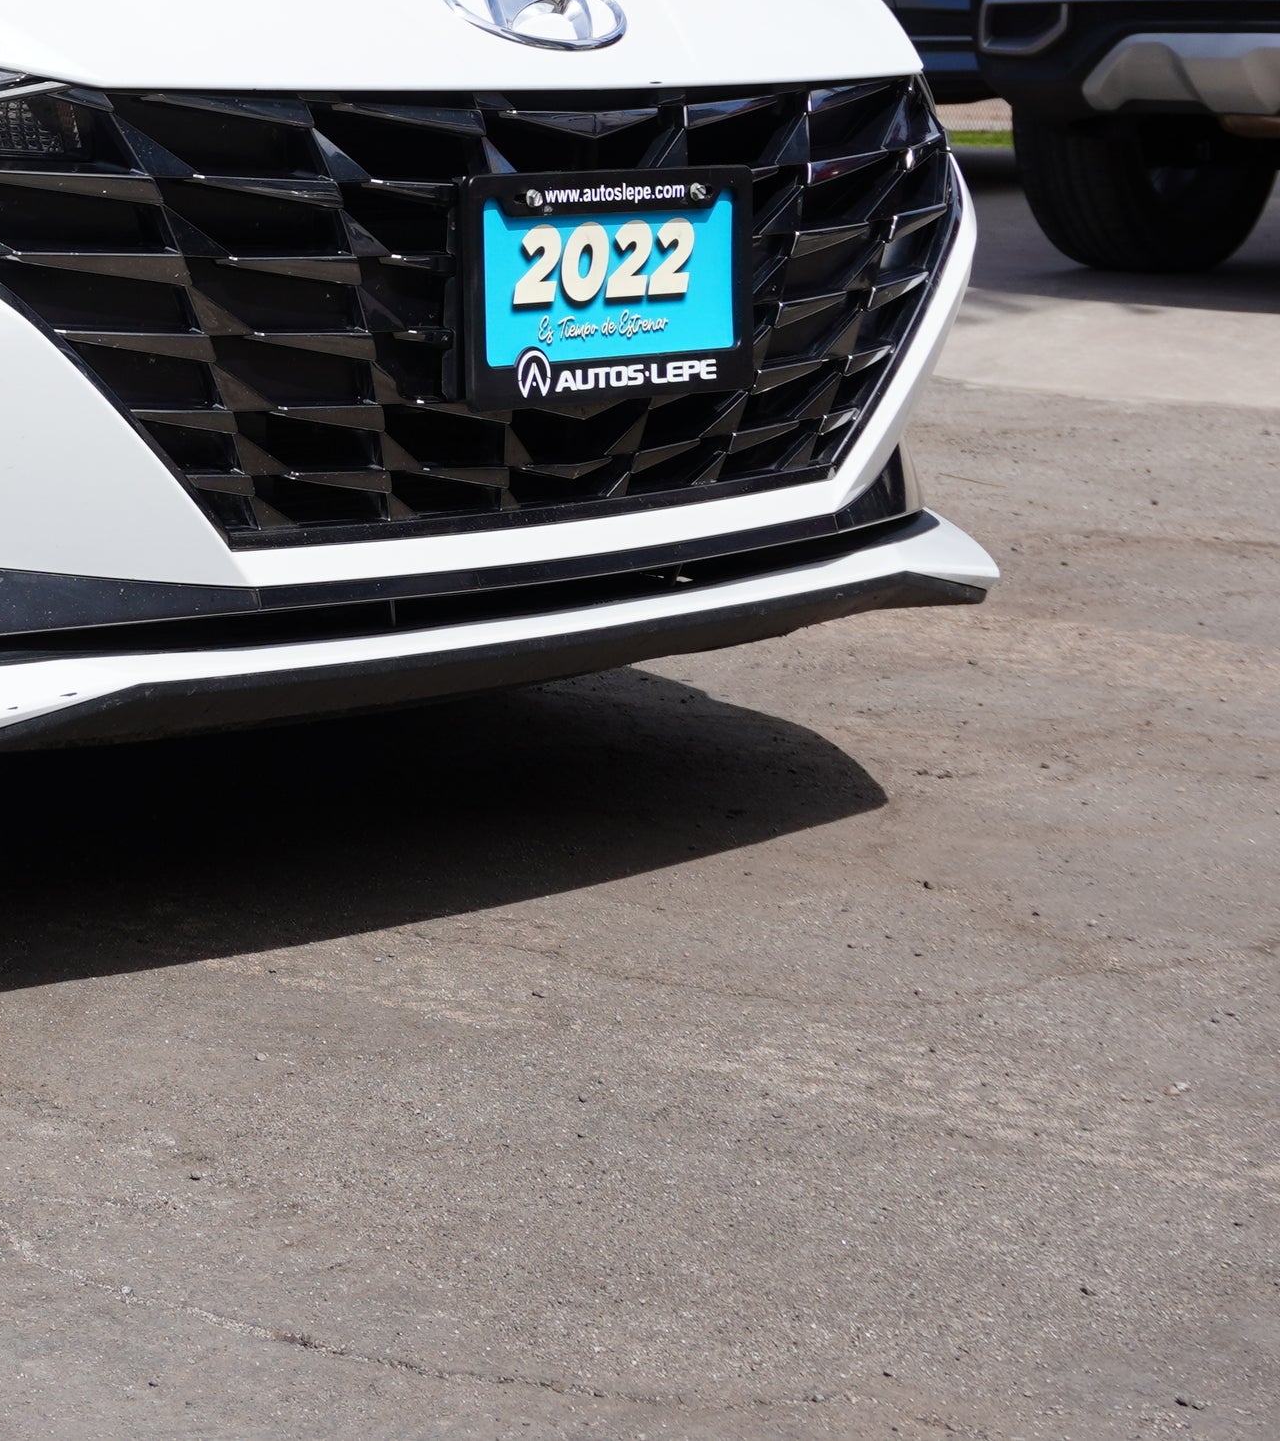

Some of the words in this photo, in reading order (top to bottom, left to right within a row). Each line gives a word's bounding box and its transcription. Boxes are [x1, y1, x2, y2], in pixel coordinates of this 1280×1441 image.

[544, 182, 685, 204] www.autoslepe.com
[512, 217, 695, 307] 2022
[538, 315, 554, 344] Es
[557, 315, 598, 341] Tiempo
[601, 316, 617, 335] de
[617, 309, 669, 338] Estrenar
